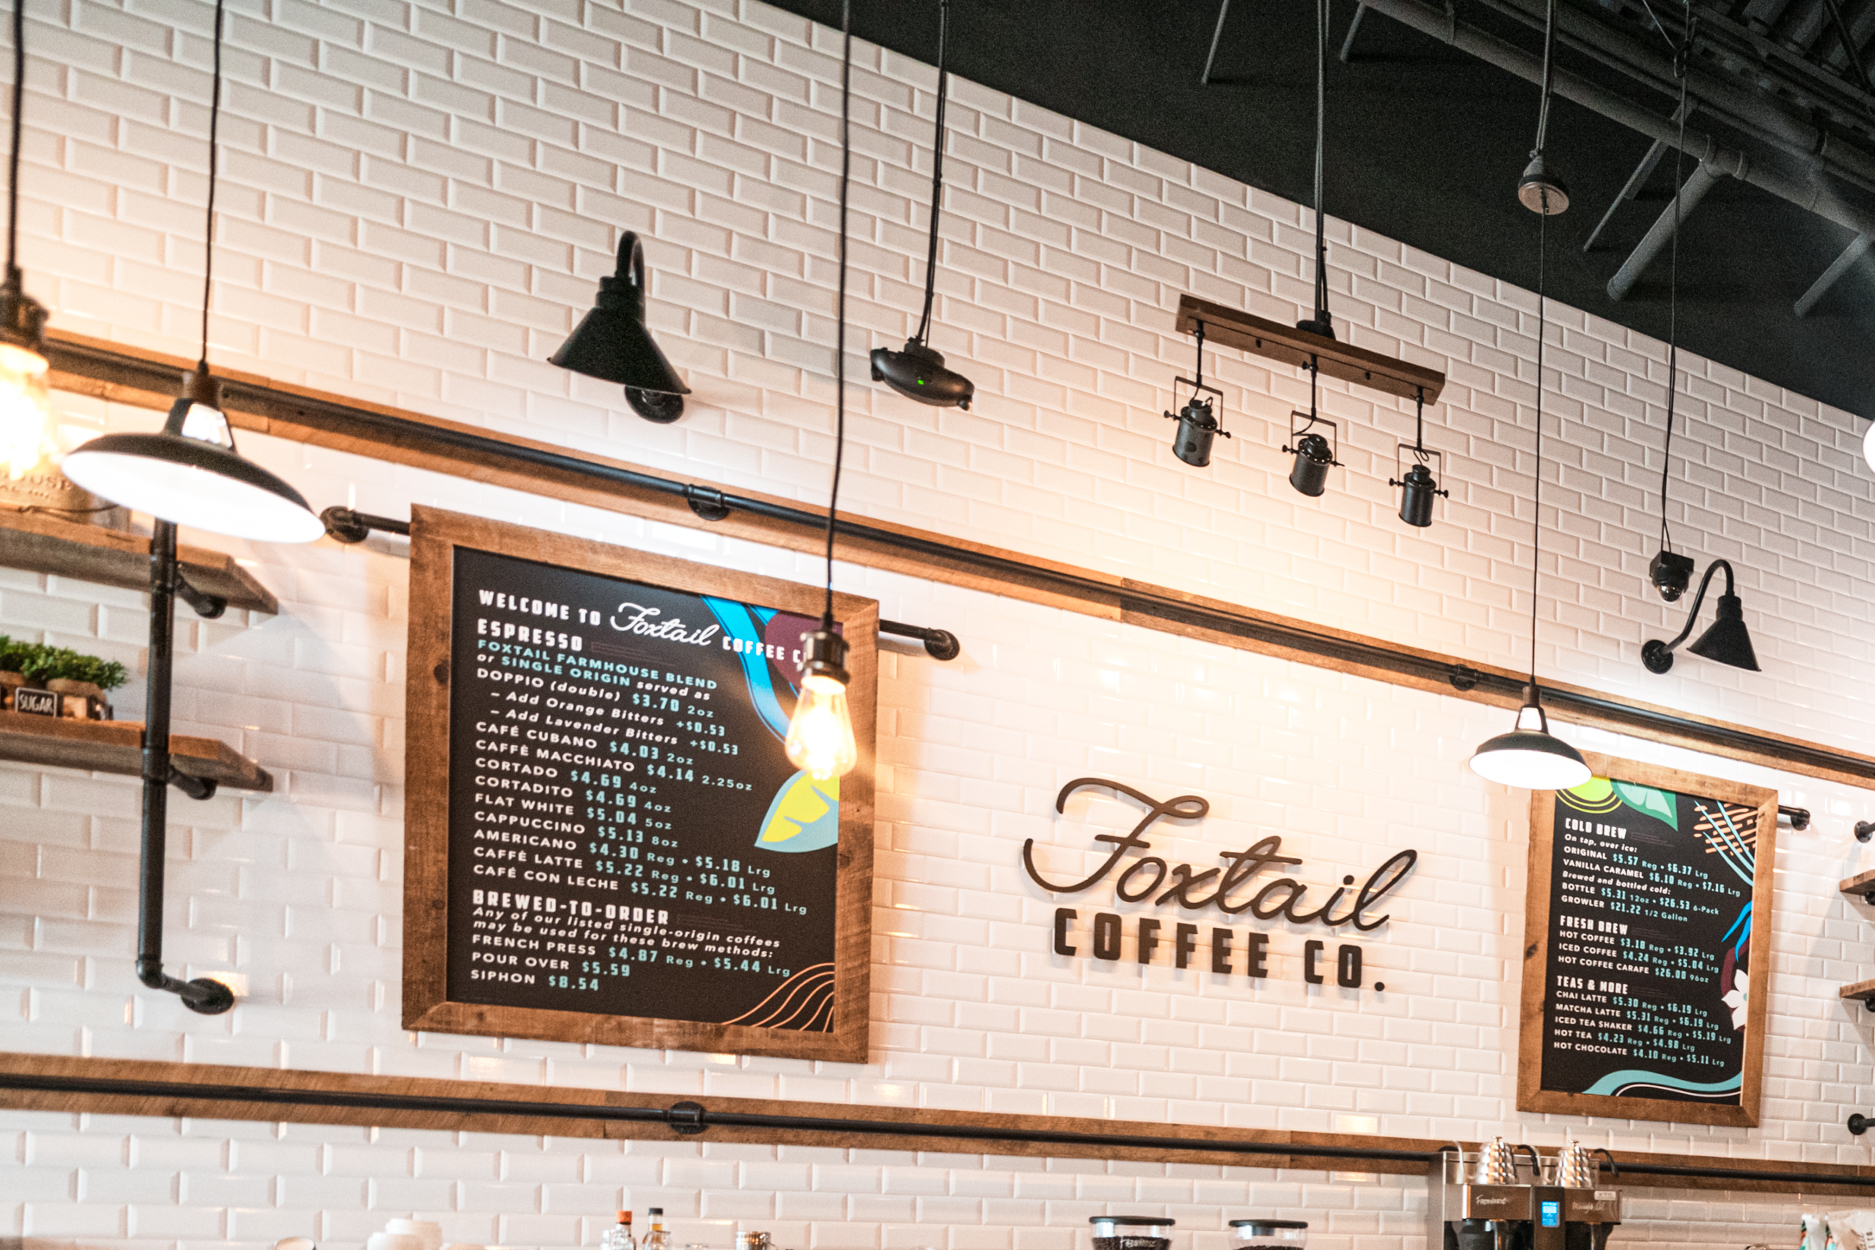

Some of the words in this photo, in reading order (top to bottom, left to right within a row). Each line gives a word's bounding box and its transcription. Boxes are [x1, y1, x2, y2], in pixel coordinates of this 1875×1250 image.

[477, 618, 583, 652] ESPRESSO
[478, 589, 570, 621] WELCOME
[578, 608, 601, 626] TO
[609, 601, 721, 647] Foxtail
[722, 635, 785, 661] COFFEE
[476, 653, 495, 663] or
[501, 655, 563, 675] SINGLE
[569, 667, 630, 687] ORIGIN
[636, 681, 689, 697] served
[693, 691, 711, 701] as
[478, 639, 550, 661] FOXTAIL
[557, 653, 659, 680] FARMHOUSE
[665, 672, 718, 690] BLEND
[19, 693, 53, 712] SUGAR
[476, 667, 544, 688] DOPPIO
[550, 680, 621, 702] (double)
[632, 692, 680, 712] $3.70
[687, 705, 714, 718] 2oz
[505, 691, 540, 705] Add
[546, 697, 605, 717] Orange
[611, 708, 664, 726] Bitters
[676, 720, 725, 737] +$0.53
[475, 721, 519, 737] CAFÉ
[526, 729, 598, 749] CUBANO
[609, 741, 659, 760] $4.03
[667, 752, 693, 765] 2oz
[505, 708, 540, 723] Add
[545, 714, 620, 735] Lavender
[625, 727, 678, 745] Bitters
[690, 739, 738, 756] +$0.53
[475, 739, 529, 757] CAFFÈ
[536, 748, 635, 772] MACCHIATO
[647, 764, 694, 782] $4.14
[702, 775, 752, 791] 2.25oz
[475, 757, 558, 778] CORTADO
[570, 769, 622, 789] $4.69
[629, 781, 657, 794] 4oz
[474, 775, 573, 798] CORTADITO
[586, 789, 637, 808] $4.69
[644, 801, 671, 813] 4oz
[474, 792, 515, 807] FLAT
[520, 799, 574, 816] WHITE
[587, 807, 637, 825] $5.04
[645, 818, 672, 830] 5oz
[474, 810, 586, 835] CAPPUCCINO
[598, 825, 643, 843] $5.13
[651, 836, 678, 848] 8oz
[1564, 833, 1578, 842] On
[1599, 840, 1619, 850] over
[1621, 843, 1638, 853] ice:
[1565, 817, 1593, 833] COLD
[1596, 823, 1627, 840] BREW
[473, 828, 577, 851] AMERICANO
[589, 842, 639, 860] $4.30
[695, 855, 740, 873] $5.18
[473, 846, 527, 862] CAFFÈ
[534, 853, 583, 869] LATTE
[595, 860, 643, 877] $5.22
[700, 873, 745, 890] $6.01
[1023, 777, 1418, 931] Foxtail
[1563, 845, 1608, 860] ORIGINAL
[1562, 858, 1601, 872] VANILLA
[1603, 865, 1644, 879] CARAMEL
[1562, 870, 1595, 883] Brewed
[1596, 877, 1614, 886] and
[1615, 879, 1648, 891] bottled
[1649, 886, 1671, 895] cold:
[473, 864, 517, 879] CAFÉ
[523, 870, 560, 884] CON
[567, 875, 619, 891] LECHE
[631, 881, 678, 898] $5.22
[733, 893, 778, 910] $6.01
[1560, 894, 1605, 909] GROWLER
[1561, 881, 1596, 895] BOTTLE
[472, 889, 669, 925] BREWED-TO-ORDER
[472, 906, 504, 921] Any
[510, 910, 529, 921] of
[533, 914, 561, 925] our
[567, 915, 614, 930] listed
[619, 922, 720, 942] single-origin
[726, 934, 780, 948] coffees
[473, 920, 507, 933] may
[512, 922, 533, 934] be
[539, 927, 578, 938] used
[584, 929, 607, 941] for
[613, 933, 655, 946] these
[661, 937, 699, 951] brew
[704, 944, 773, 958] methods:
[1559, 914, 1594, 931] FRESH
[1598, 920, 1628, 936] BREW
[1559, 929, 1579, 939] HOT
[1580, 932, 1615, 945] COFFEE
[471, 951, 518, 966] POUR
[524, 956, 570, 970] OVER
[582, 961, 630, 977] $5.59
[472, 933, 540, 950] FRENCH
[546, 941, 596, 956] PRESS
[608, 946, 658, 963] $4.87
[714, 957, 761, 973] $5.44
[1053, 907, 1270, 978] COFFEE
[1304, 939, 1386, 993] CO.
[1557, 955, 1578, 965] HOT
[1579, 957, 1614, 970] COFFEE
[1615, 962, 1650, 974] CARAFE
[1558, 942, 1581, 953] ICED
[1582, 945, 1617, 958] COFFEE
[470, 969, 536, 985] SIPHON
[548, 975, 599, 991] $8.54
[1555, 990, 1579, 1000] CHAI
[1580, 993, 1607, 1004] LATTE
[1556, 975, 1584, 990] TEAS
[1587, 979, 1595, 991] &
[1599, 980, 1628, 995] MORE
[1554, 1015, 1577, 1025] ICED
[1578, 1018, 1596, 1027] TEA
[1598, 1020, 1633, 1031] SHAKER
[1555, 1002, 1593, 1014] MATCHA
[1594, 1007, 1621, 1018] LATTE
[1553, 1028, 1573, 1037] HOT
[1575, 1030, 1593, 1040] TEA
[1553, 1041, 1573, 1050] HOT
[1574, 1043, 1628, 1056] CHOCOLATE
